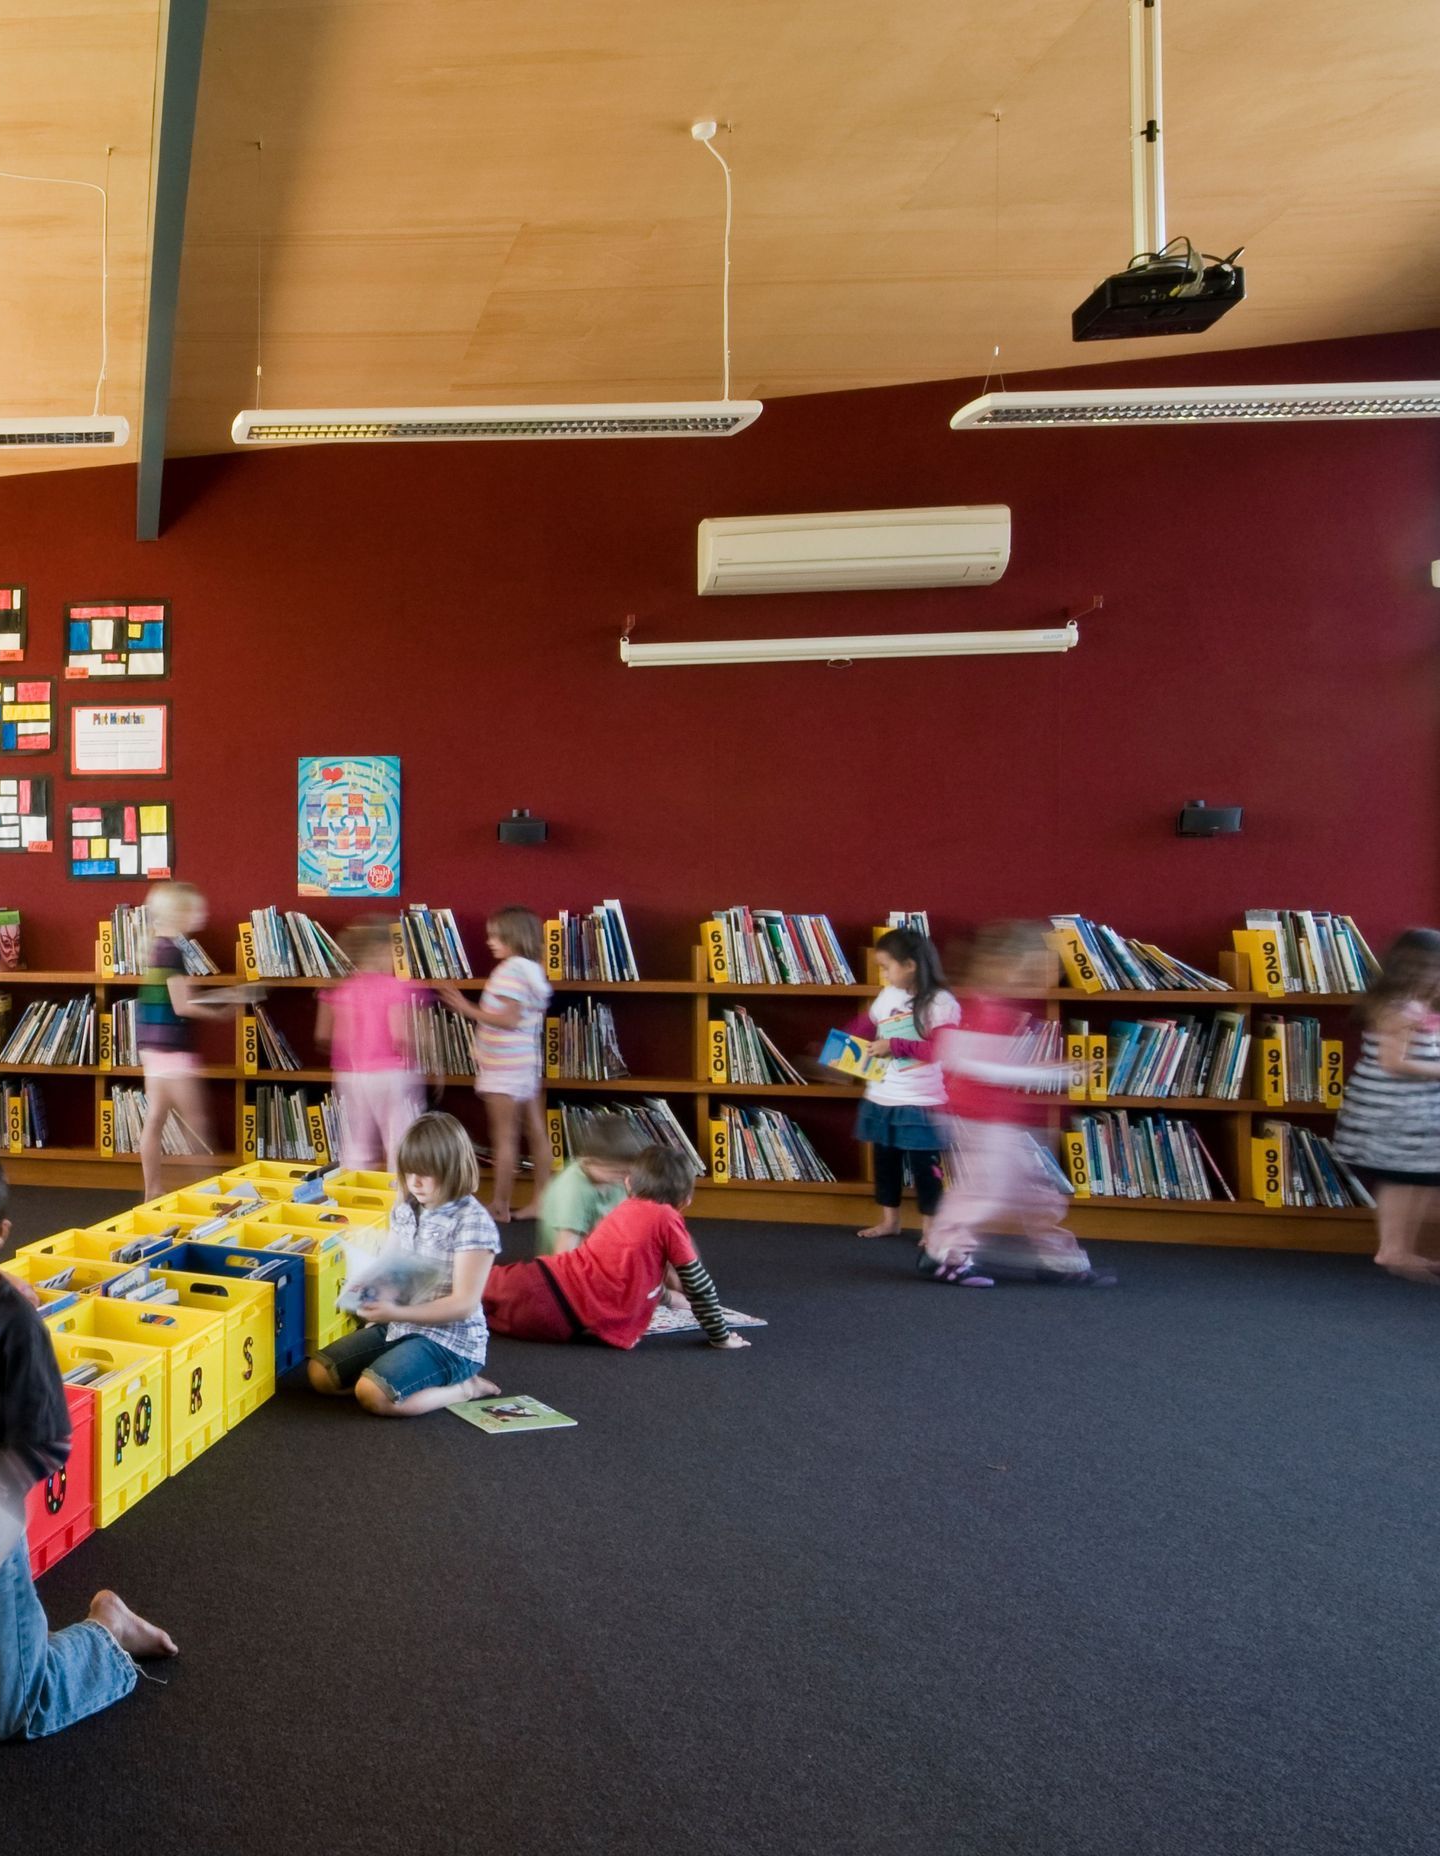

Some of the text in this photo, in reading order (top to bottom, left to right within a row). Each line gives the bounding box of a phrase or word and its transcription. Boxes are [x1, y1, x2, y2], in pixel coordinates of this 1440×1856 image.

[93, 712, 145, 726] Piet Mondrian
[343, 761, 386, 779] Roald
[102, 929, 112, 967] 500
[243, 931, 256, 969] 550
[549, 930, 559, 969] 598
[710, 930, 726, 972] 620
[1067, 940, 1094, 980] 796
[1263, 941, 1282, 985] 920
[100, 1022, 110, 1059] 520
[245, 1025, 256, 1063] 560
[548, 1027, 559, 1065] 599
[712, 1030, 725, 1072] 630
[1092, 1046, 1104, 1087] 821
[1267, 1049, 1281, 1094] 941
[1328, 1052, 1342, 1096] 970
[11, 1108, 20, 1142] 400
[103, 1110, 112, 1148] 530
[244, 1114, 254, 1152] 570
[310, 1115, 325, 1153] 580
[550, 1118, 561, 1158] 600
[714, 1132, 726, 1174] 640
[1071, 1142, 1085, 1184] 900
[1265, 1149, 1279, 1193] 990
[243, 1336, 254, 1380] S
[191, 1367, 202, 1415] R
